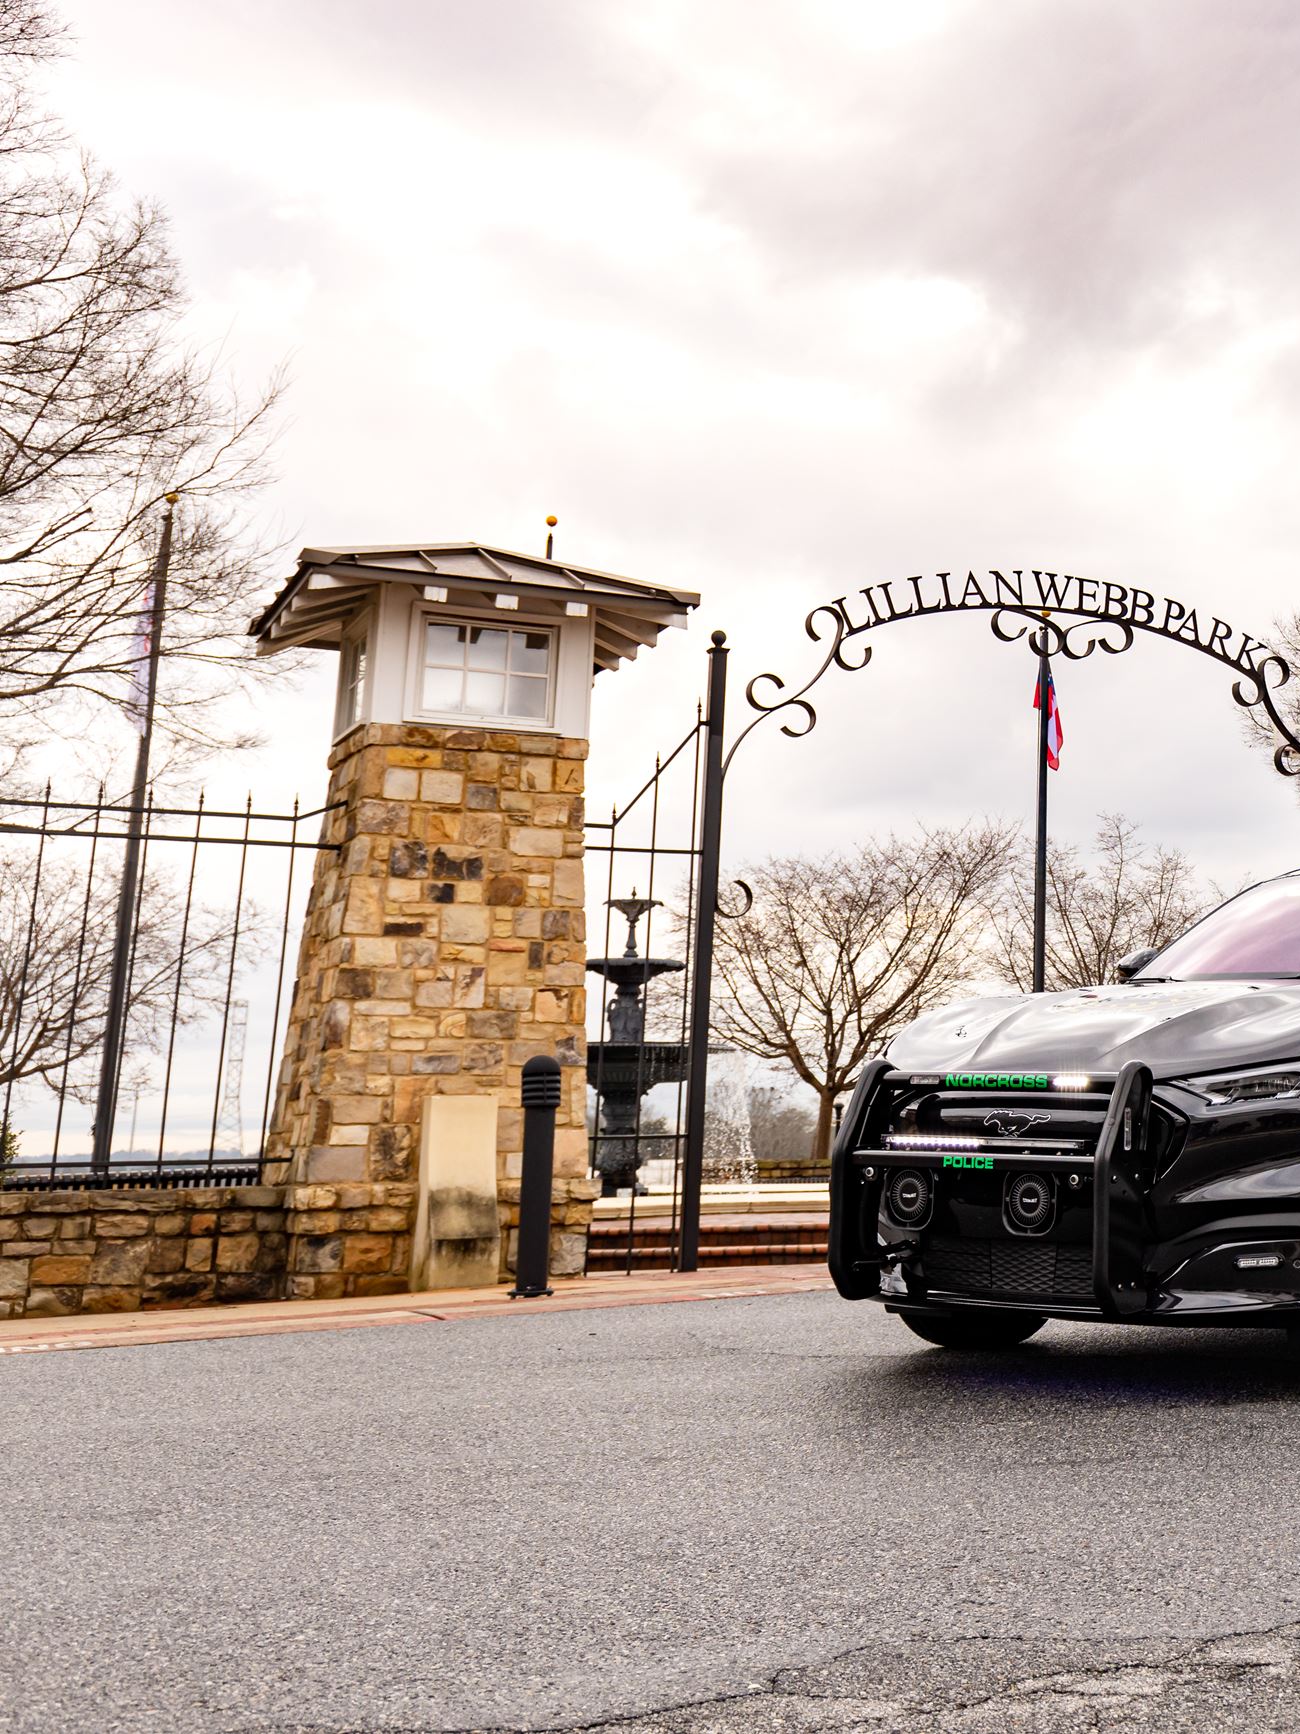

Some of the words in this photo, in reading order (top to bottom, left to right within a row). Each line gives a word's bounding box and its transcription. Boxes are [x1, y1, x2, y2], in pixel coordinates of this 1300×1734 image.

[831, 570, 1023, 637] LILLIAN
[1032, 570, 1155, 627] WEBB
[1158, 598, 1267, 672] PARK
[945, 1073, 1048, 1089] NORCROSS
[943, 1156, 994, 1170] POLICE
